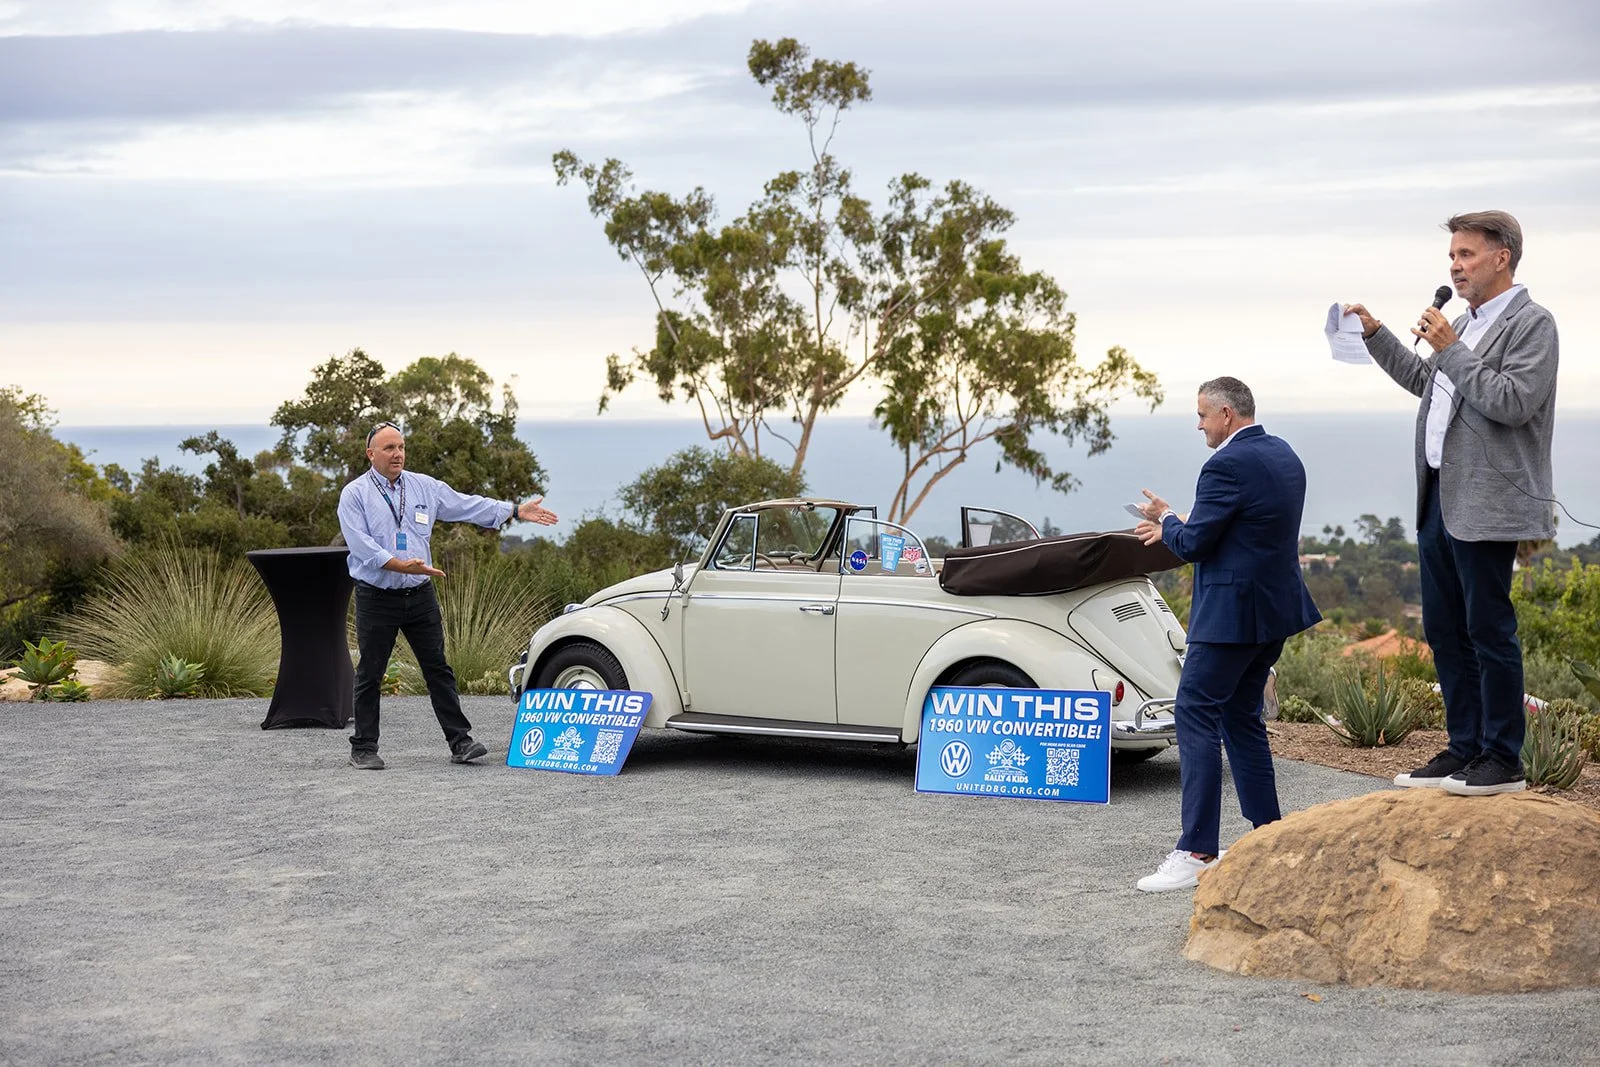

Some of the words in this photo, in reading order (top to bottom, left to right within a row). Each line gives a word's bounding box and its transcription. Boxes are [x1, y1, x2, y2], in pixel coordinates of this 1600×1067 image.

[525, 692, 576, 710] WIN
[580, 693, 644, 713] THIS
[930, 692, 1003, 717] WIN
[1011, 695, 1100, 721] THIS
[519, 711, 542, 723] 1960
[544, 712, 563, 723] VW
[562, 713, 642, 727] CONVERTIBLE!
[928, 718, 964, 733] 1960
[966, 719, 991, 734] VW
[992, 720, 1102, 740] CONVERTIBLE!
[525, 759, 598, 772] UNITEDBG.ORG.COM
[984, 773, 1005, 782] RALLY
[1011, 775, 1029, 783] KIDS
[955, 782, 1060, 797] UNITEDBG.ORG.COM
